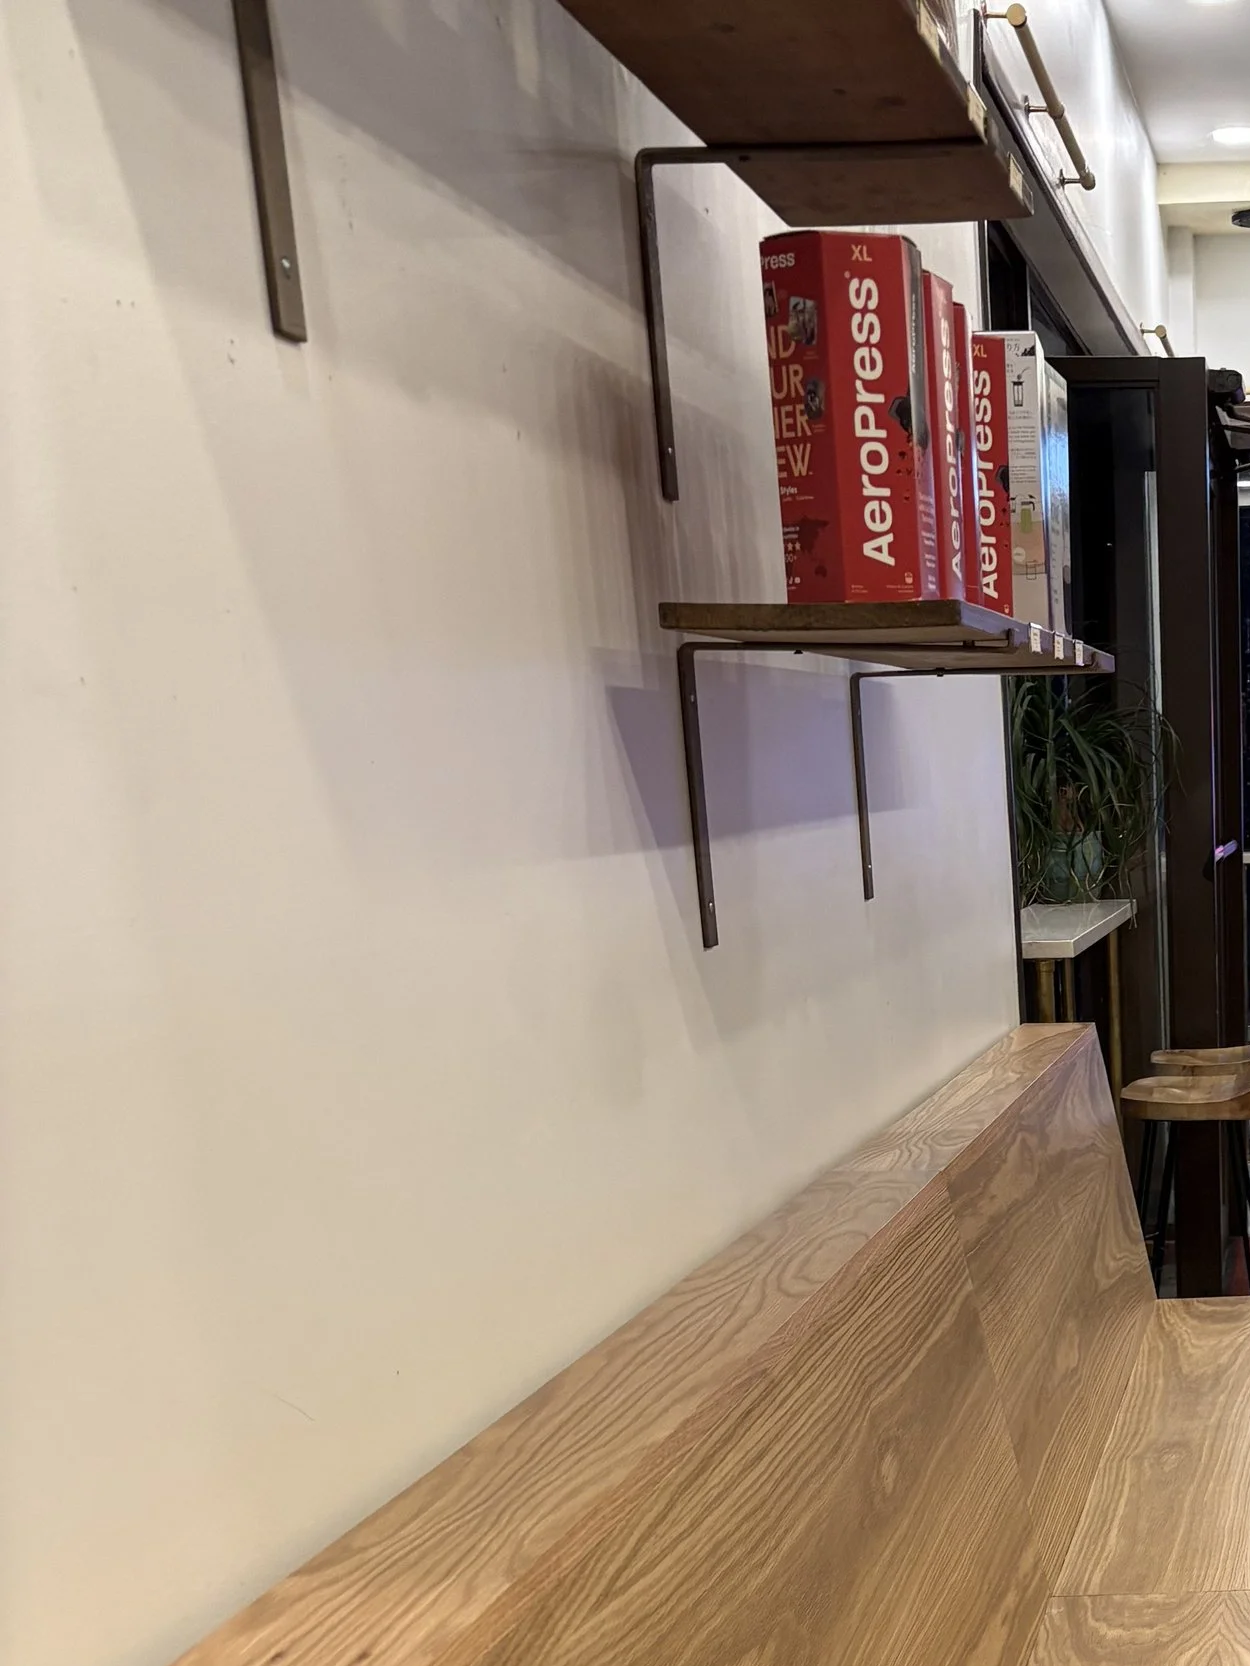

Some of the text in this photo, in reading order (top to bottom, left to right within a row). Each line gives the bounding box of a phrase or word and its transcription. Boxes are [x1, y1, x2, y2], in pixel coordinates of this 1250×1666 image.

[851, 244, 872, 262] XL
[973, 343, 987, 358] XL
[848, 277, 896, 567] AeroPress
[940, 318, 963, 580] AeroPress
[973, 369, 999, 600] AeroPress
